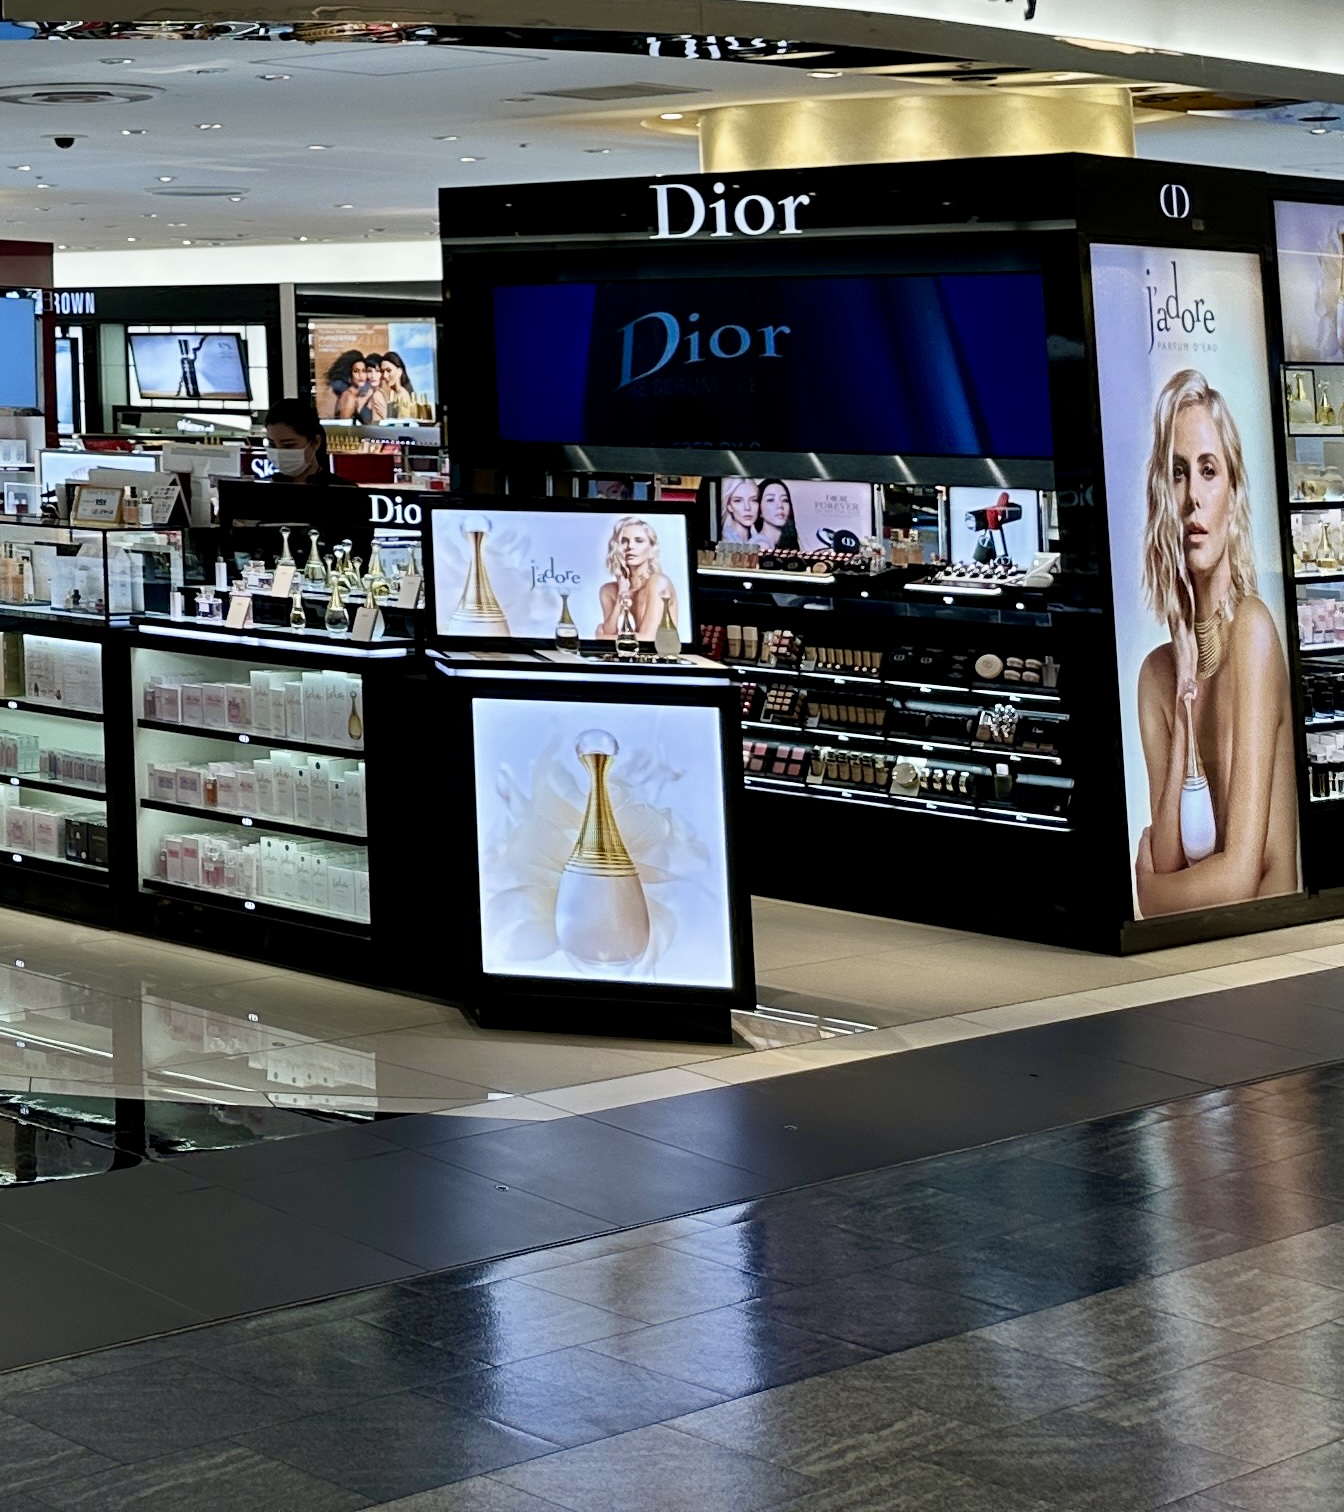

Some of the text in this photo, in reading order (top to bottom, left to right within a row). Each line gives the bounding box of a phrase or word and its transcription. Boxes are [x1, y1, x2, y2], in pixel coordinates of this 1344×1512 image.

[649, 182, 810, 240] Dior
[612, 311, 791, 392] Dior
[368, 494, 422, 524] Dio
